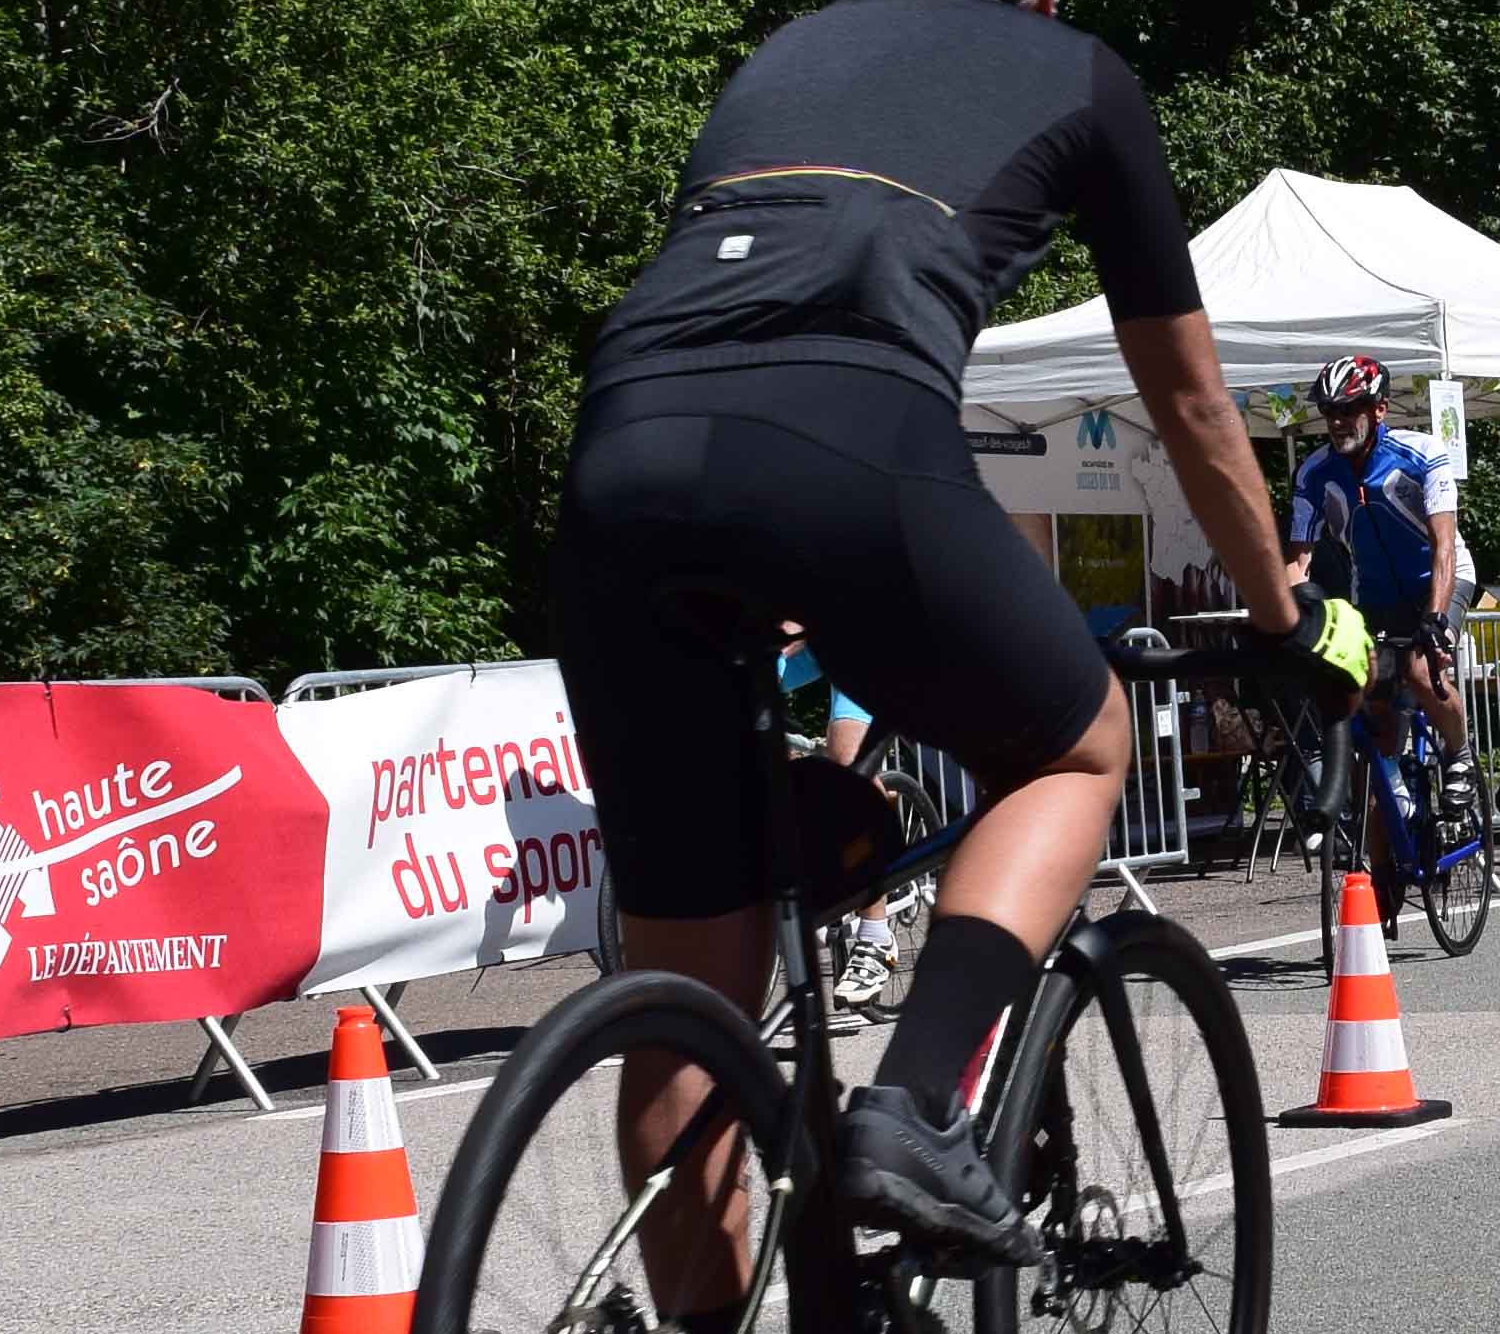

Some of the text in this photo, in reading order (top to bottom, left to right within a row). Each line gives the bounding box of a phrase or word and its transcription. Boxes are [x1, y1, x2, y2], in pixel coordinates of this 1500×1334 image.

[32, 760, 173, 841] haute
[367, 711, 593, 849] partenai
[81, 820, 218, 906] saône
[391, 827, 602, 924] du spor
[27, 931, 228, 982] LE DÉPARTEMENT
